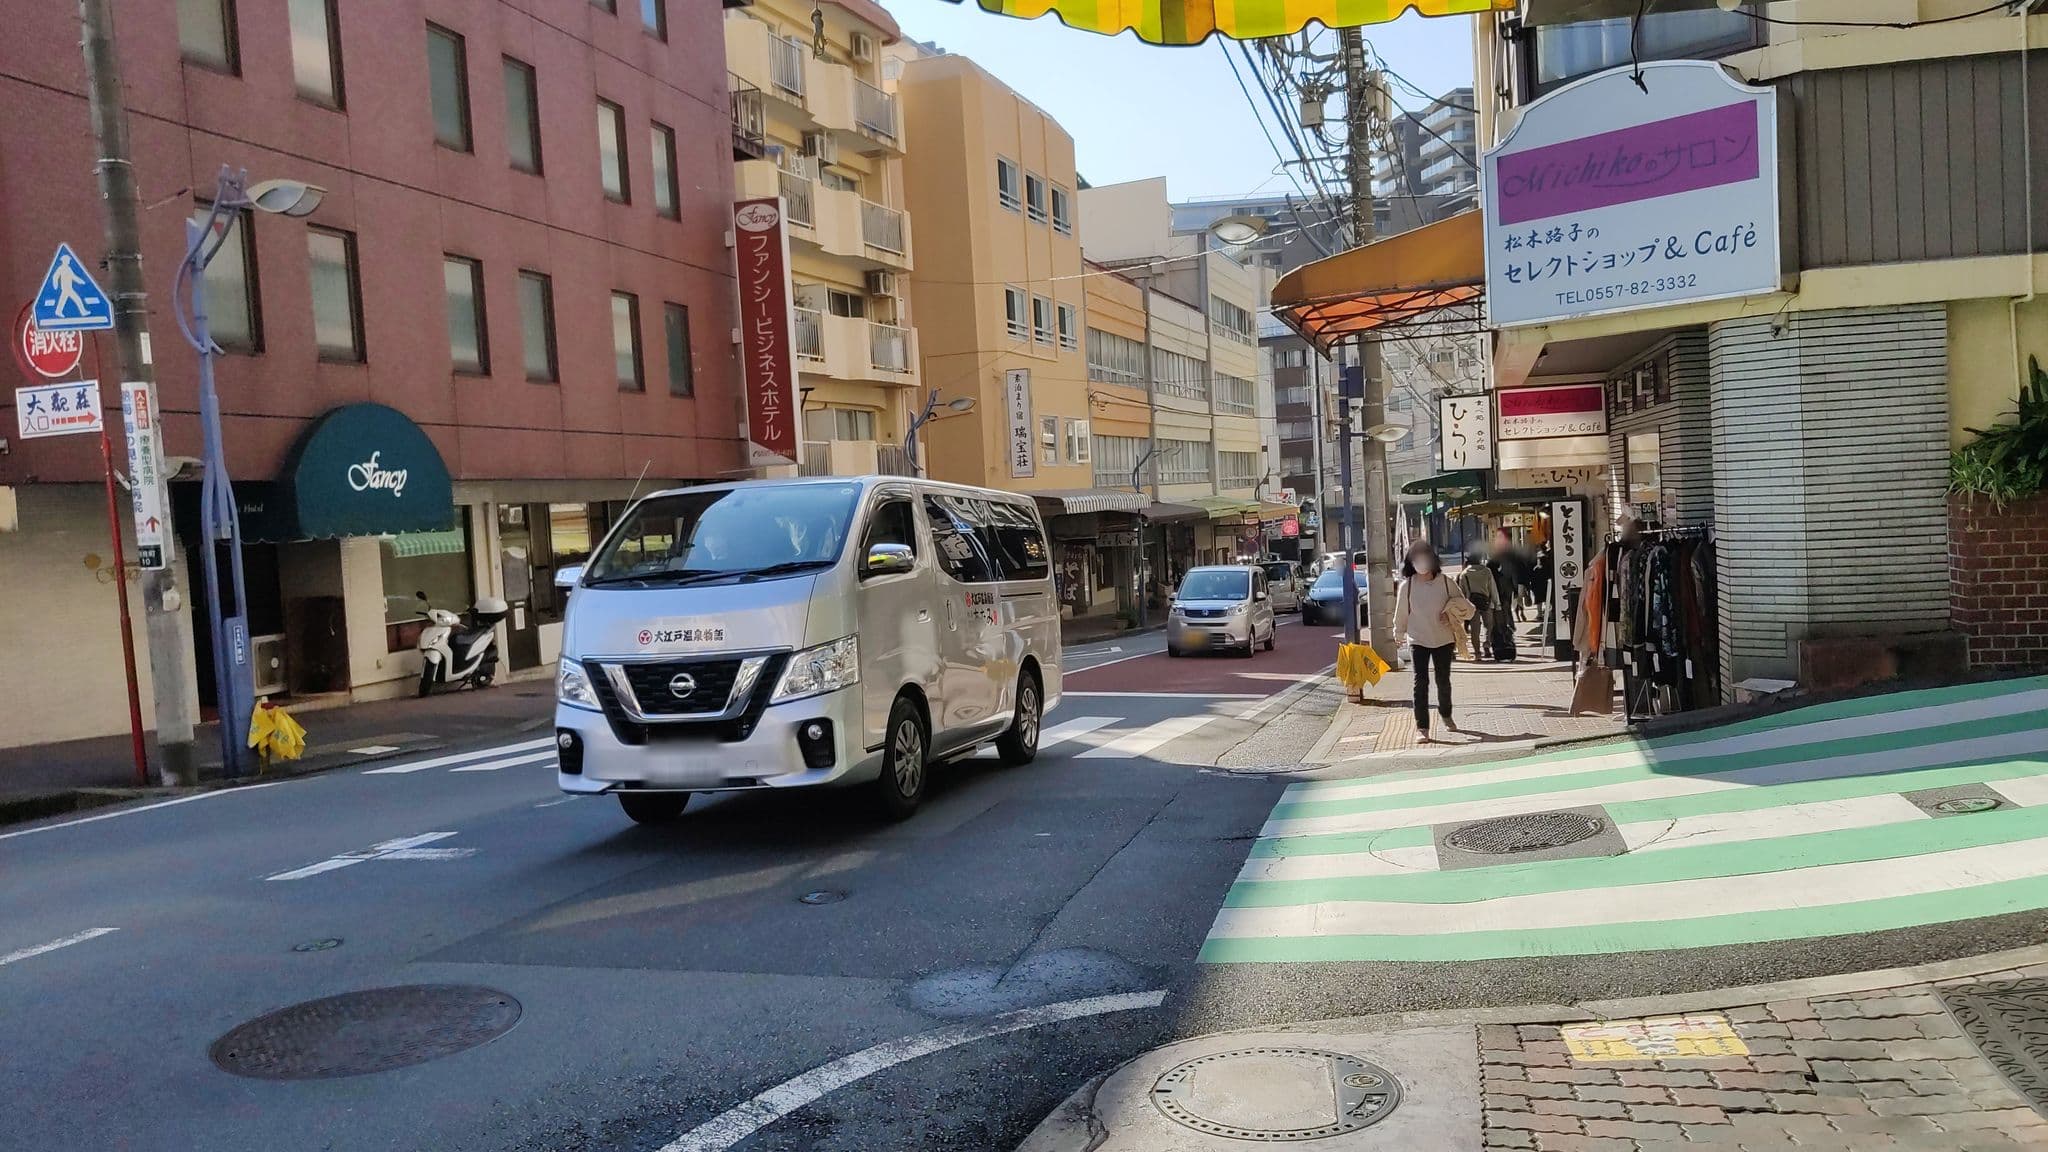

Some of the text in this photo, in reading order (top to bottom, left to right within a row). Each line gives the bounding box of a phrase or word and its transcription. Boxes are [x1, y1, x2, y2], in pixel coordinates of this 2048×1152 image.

[738, 206, 777, 227] Fancy
[1694, 221, 1758, 255] Café
[1555, 273, 1697, 305] TEL0557-82-3332
[28, 330, 78, 356] 消火栓
[750, 235, 782, 442] ファンシービジネスホテル
[24, 414, 50, 432] 入口
[1450, 402, 1468, 467] ひらり
[1578, 421, 1601, 432] Café
[348, 451, 407, 497] Fancy
[1550, 468, 1590, 485] ひらり
[1560, 504, 1575, 557] とんかつ
[654, 628, 725, 643] 大江戸温泉物語
